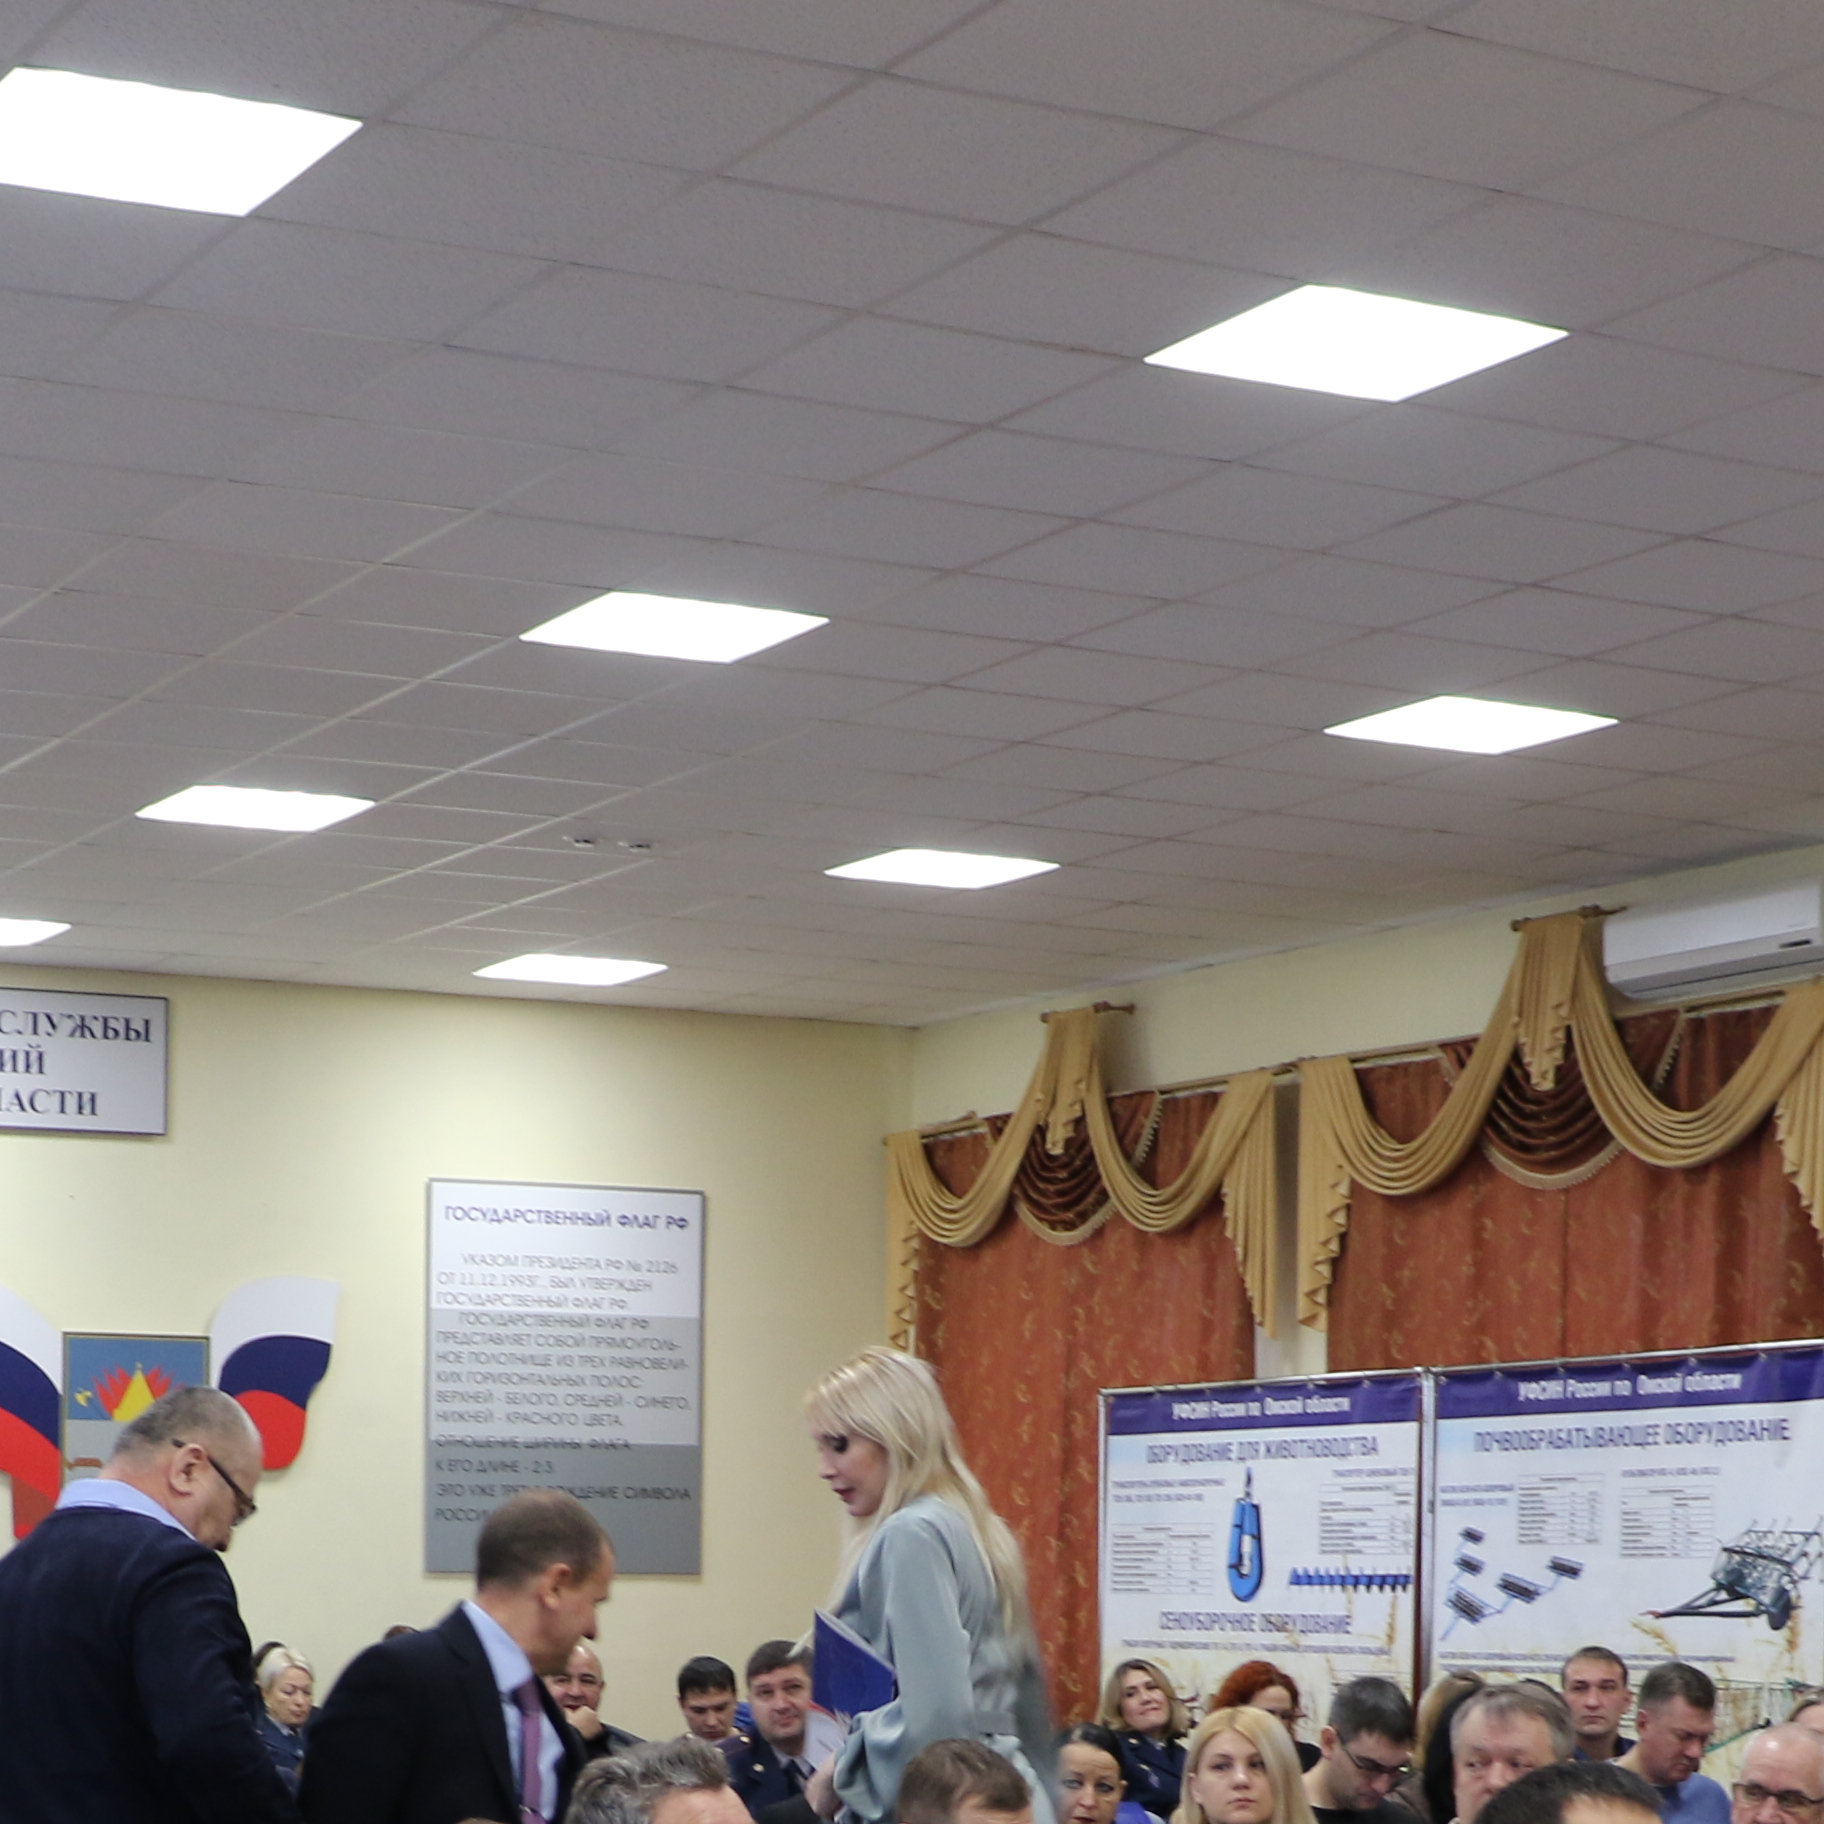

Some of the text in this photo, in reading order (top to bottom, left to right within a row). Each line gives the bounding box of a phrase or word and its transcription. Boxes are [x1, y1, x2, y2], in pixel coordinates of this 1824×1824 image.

[444, 1207, 690, 1231] ГОСУДАРСТВЕННЫЙ ФЛАГ РФ
[1517, 1371, 1742, 1401] УФСИН России по Омской области
[1473, 1417, 1792, 1453] ПОЧВООБРАБАТЫВАЮЩЕЕ ОБОРУДОВАНИЕ
